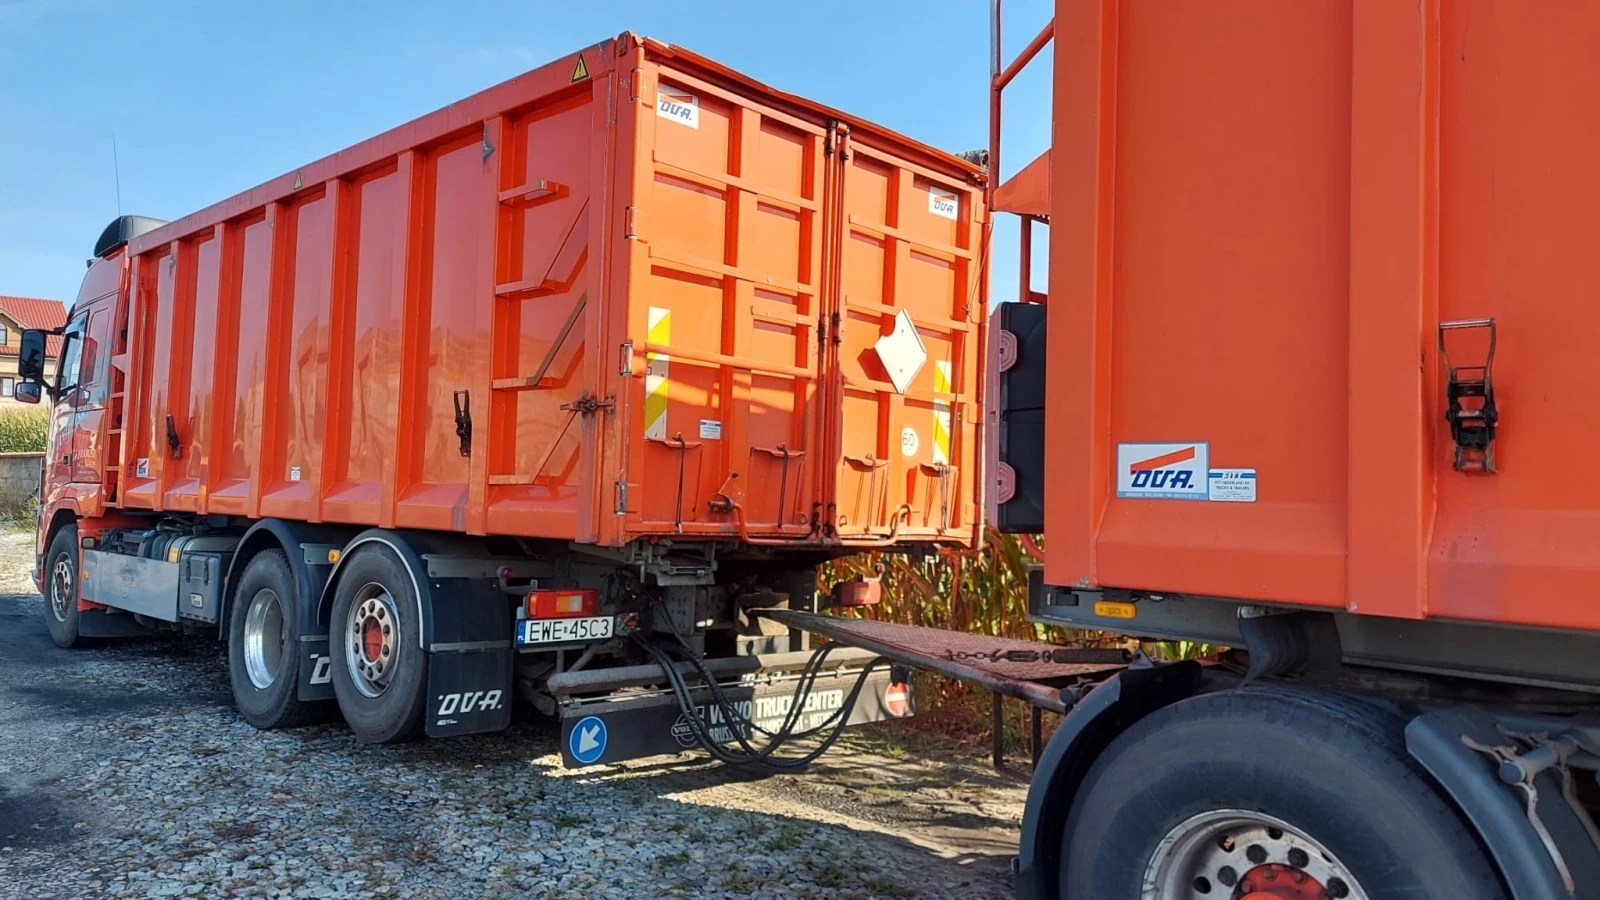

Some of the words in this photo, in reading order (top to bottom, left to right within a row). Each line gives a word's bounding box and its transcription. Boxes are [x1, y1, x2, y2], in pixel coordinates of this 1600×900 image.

[903, 432, 915, 446] 60
[529, 621, 563, 642] EWE
[569, 618, 609, 639] 45C3
